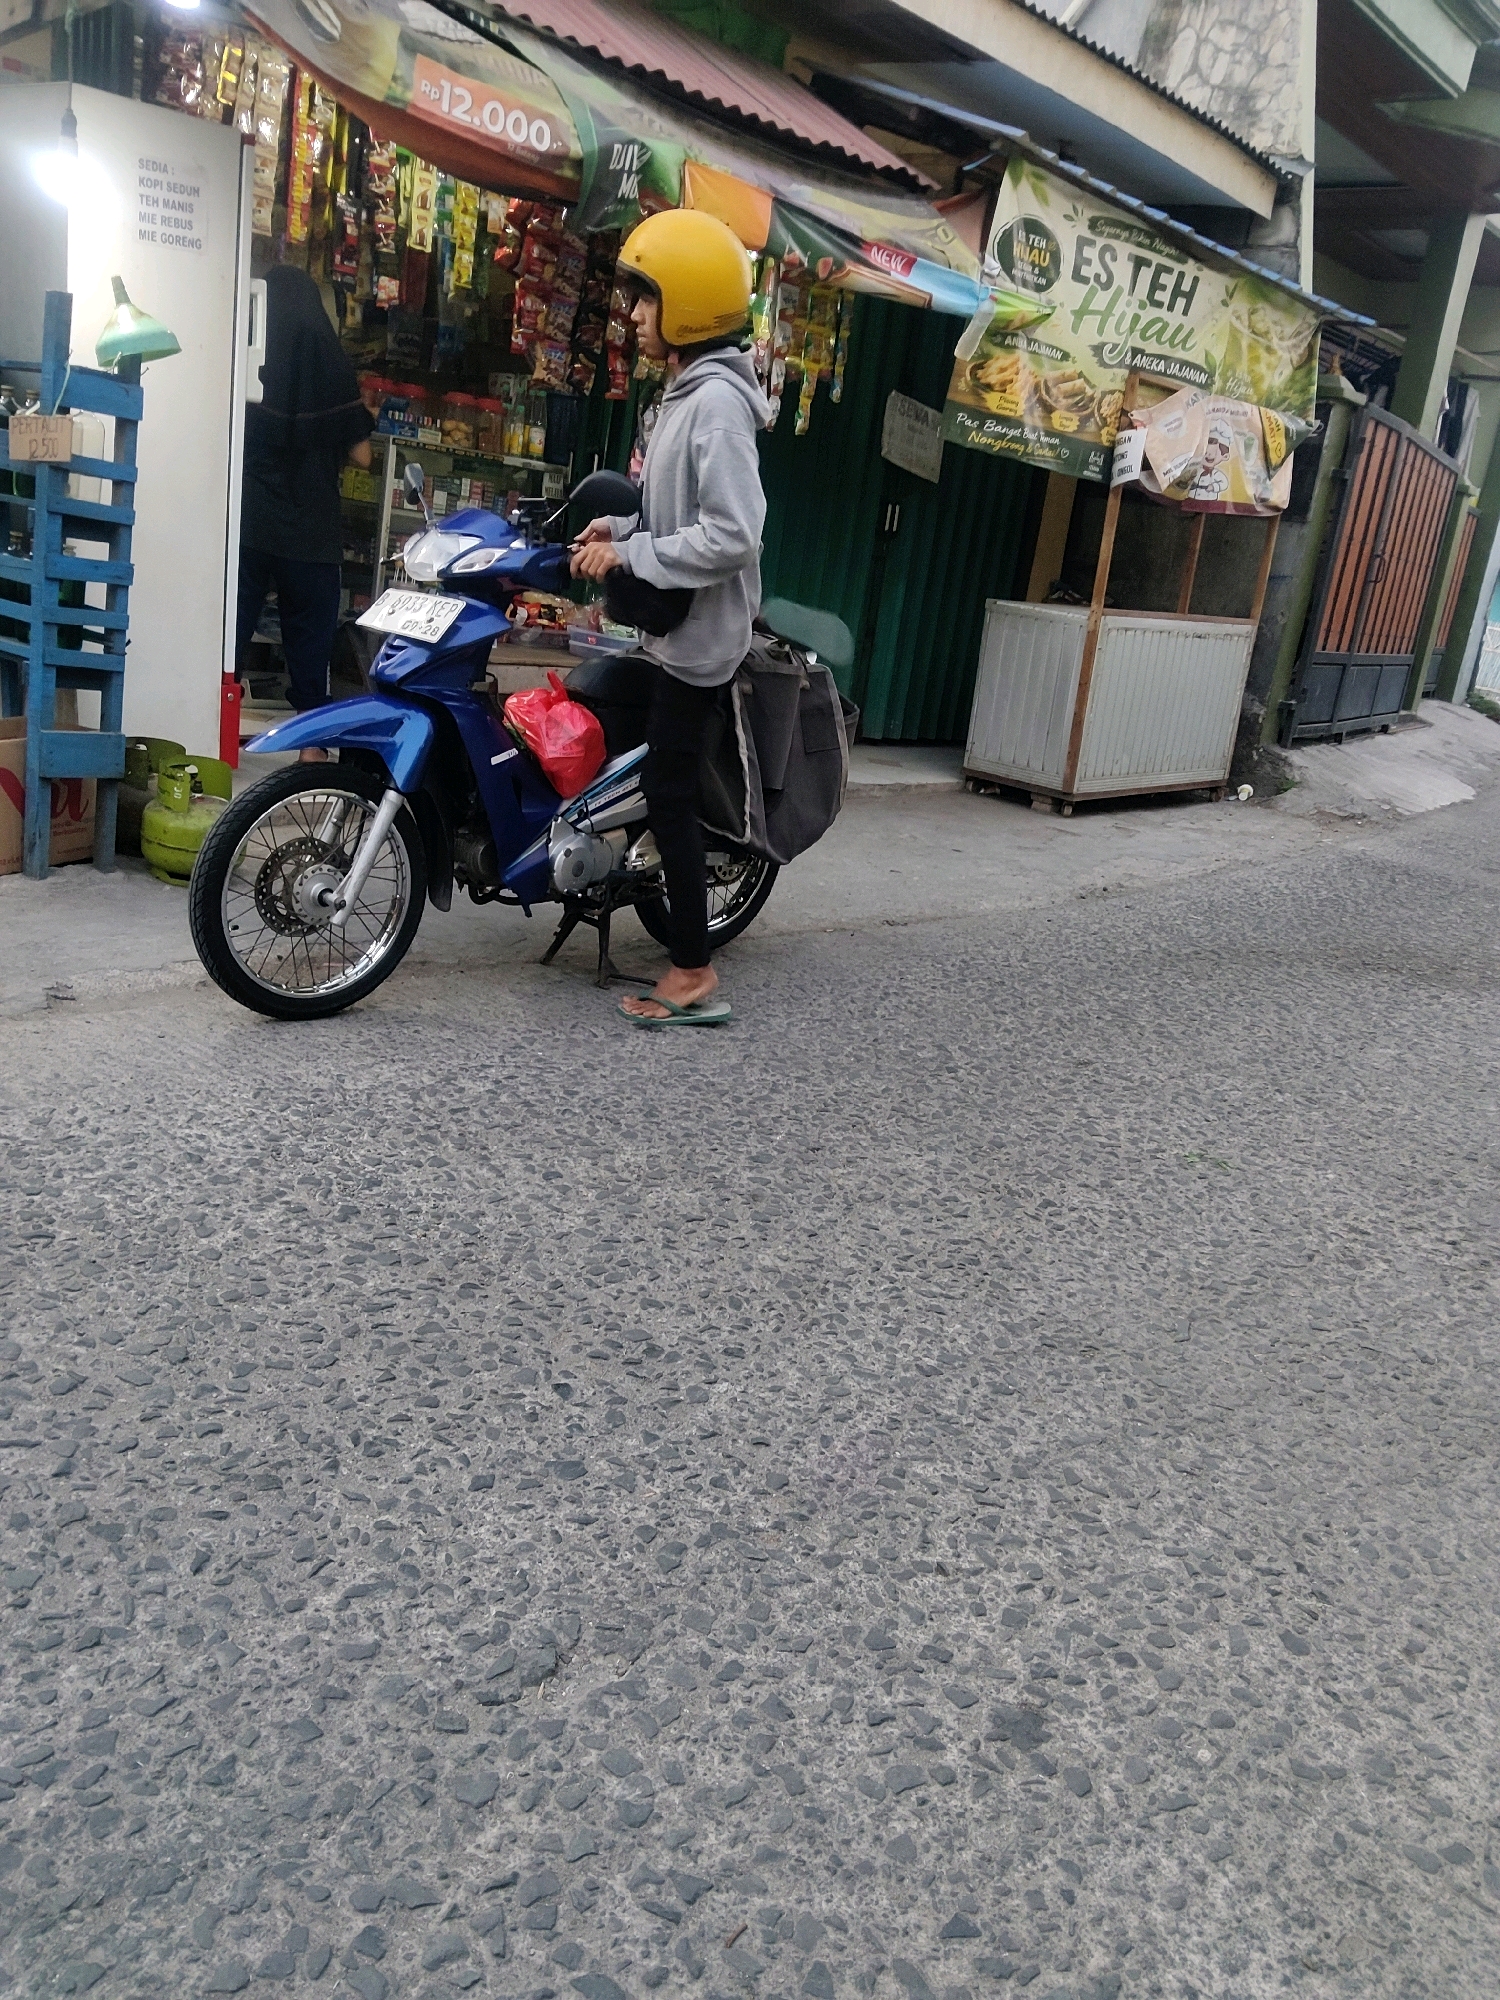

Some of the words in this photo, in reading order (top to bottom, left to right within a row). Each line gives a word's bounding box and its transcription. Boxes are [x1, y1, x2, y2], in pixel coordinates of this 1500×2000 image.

[138, 158, 168, 174] SEDIA
[139, 176, 163, 191] KOPI
[166, 181, 200, 197] SEDUH
[139, 193, 159, 208] TEH
[163, 198, 194, 214] MANIS
[139, 211, 157, 225] MIE
[161, 215, 193, 231] REBUS
[139, 229, 157, 242] MIE
[161, 232, 202, 250] GORENG
[1028, 234, 1047, 249] TEH
[870, 245, 909, 274] NEW
[1071, 234, 1118, 292] ES
[1127, 252, 1200, 317] TEH
[1070, 285, 1198, 365] Hijau
[1124, 351, 1133, 365] &
[1132, 353, 1165, 373] ANEKA
[1166, 361, 1208, 385] JAJANAN
[956, 412, 979, 428] Pas
[983, 419, 1021, 440] Banget
[374, 592, 391, 607] B
[425, 599, 460, 619] KEP
